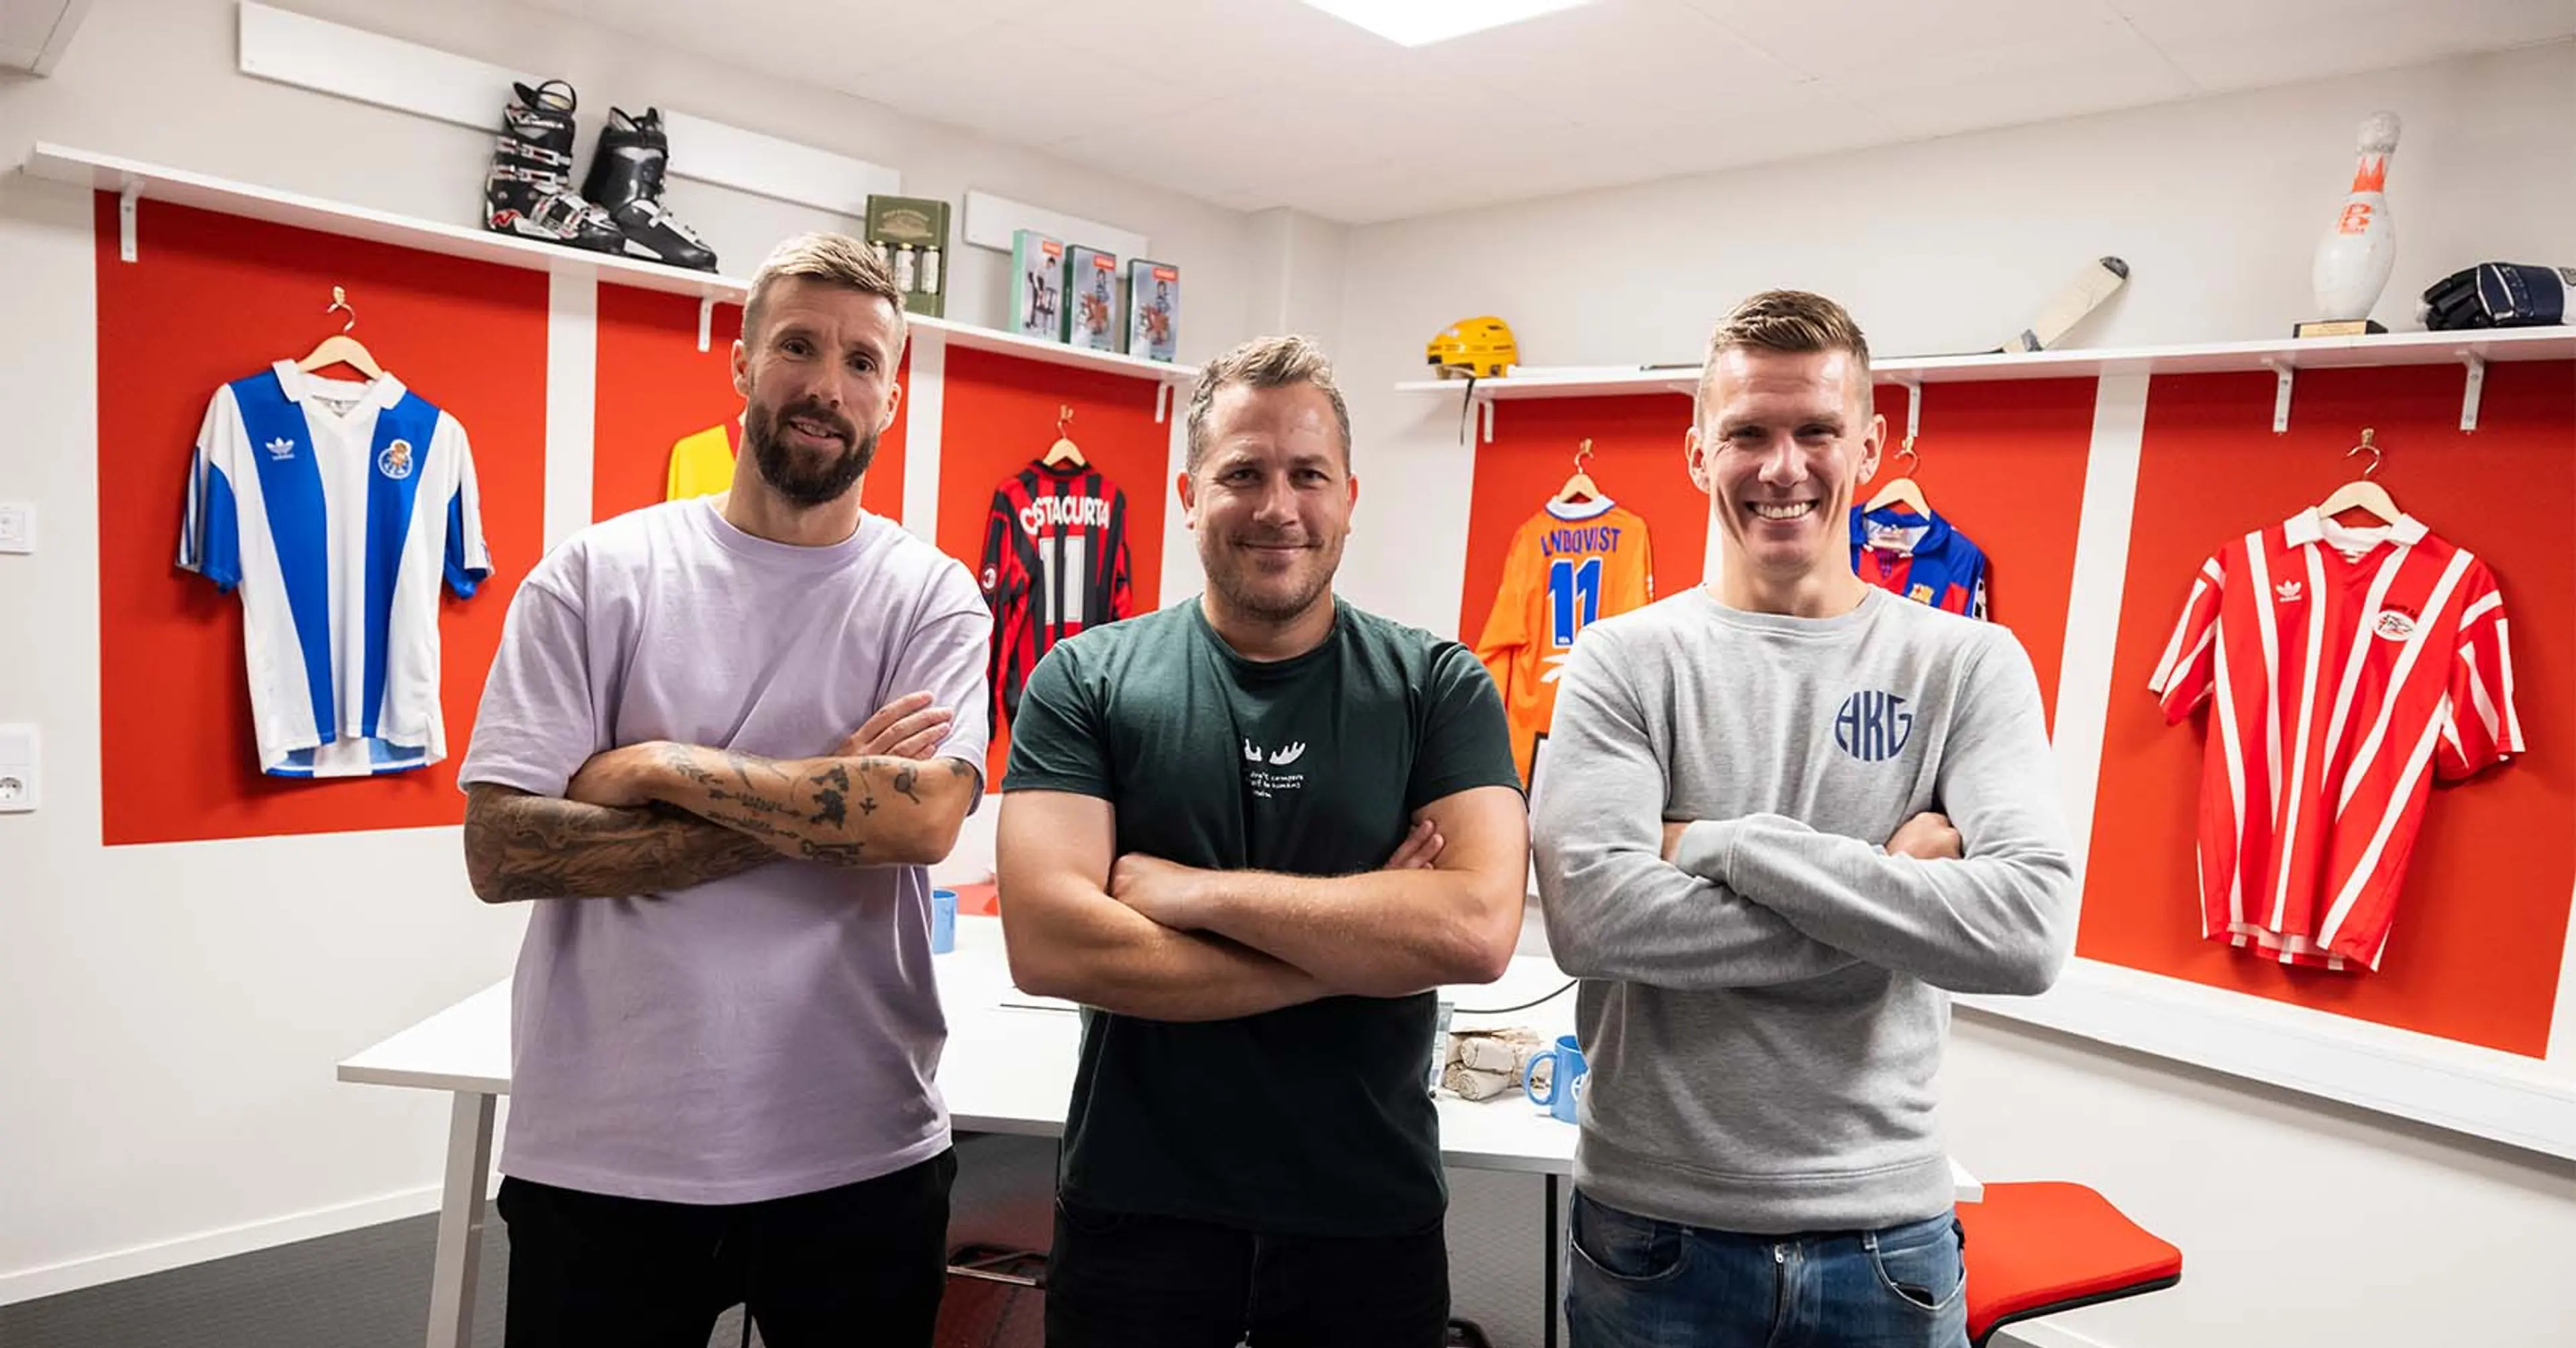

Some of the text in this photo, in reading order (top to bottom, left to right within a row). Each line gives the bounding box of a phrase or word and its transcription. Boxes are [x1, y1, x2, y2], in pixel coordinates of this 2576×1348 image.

[1020, 495, 1110, 535] CSTACURTA
[1540, 526, 1621, 557] LNDQVIST
[1548, 557, 1603, 648] 11
